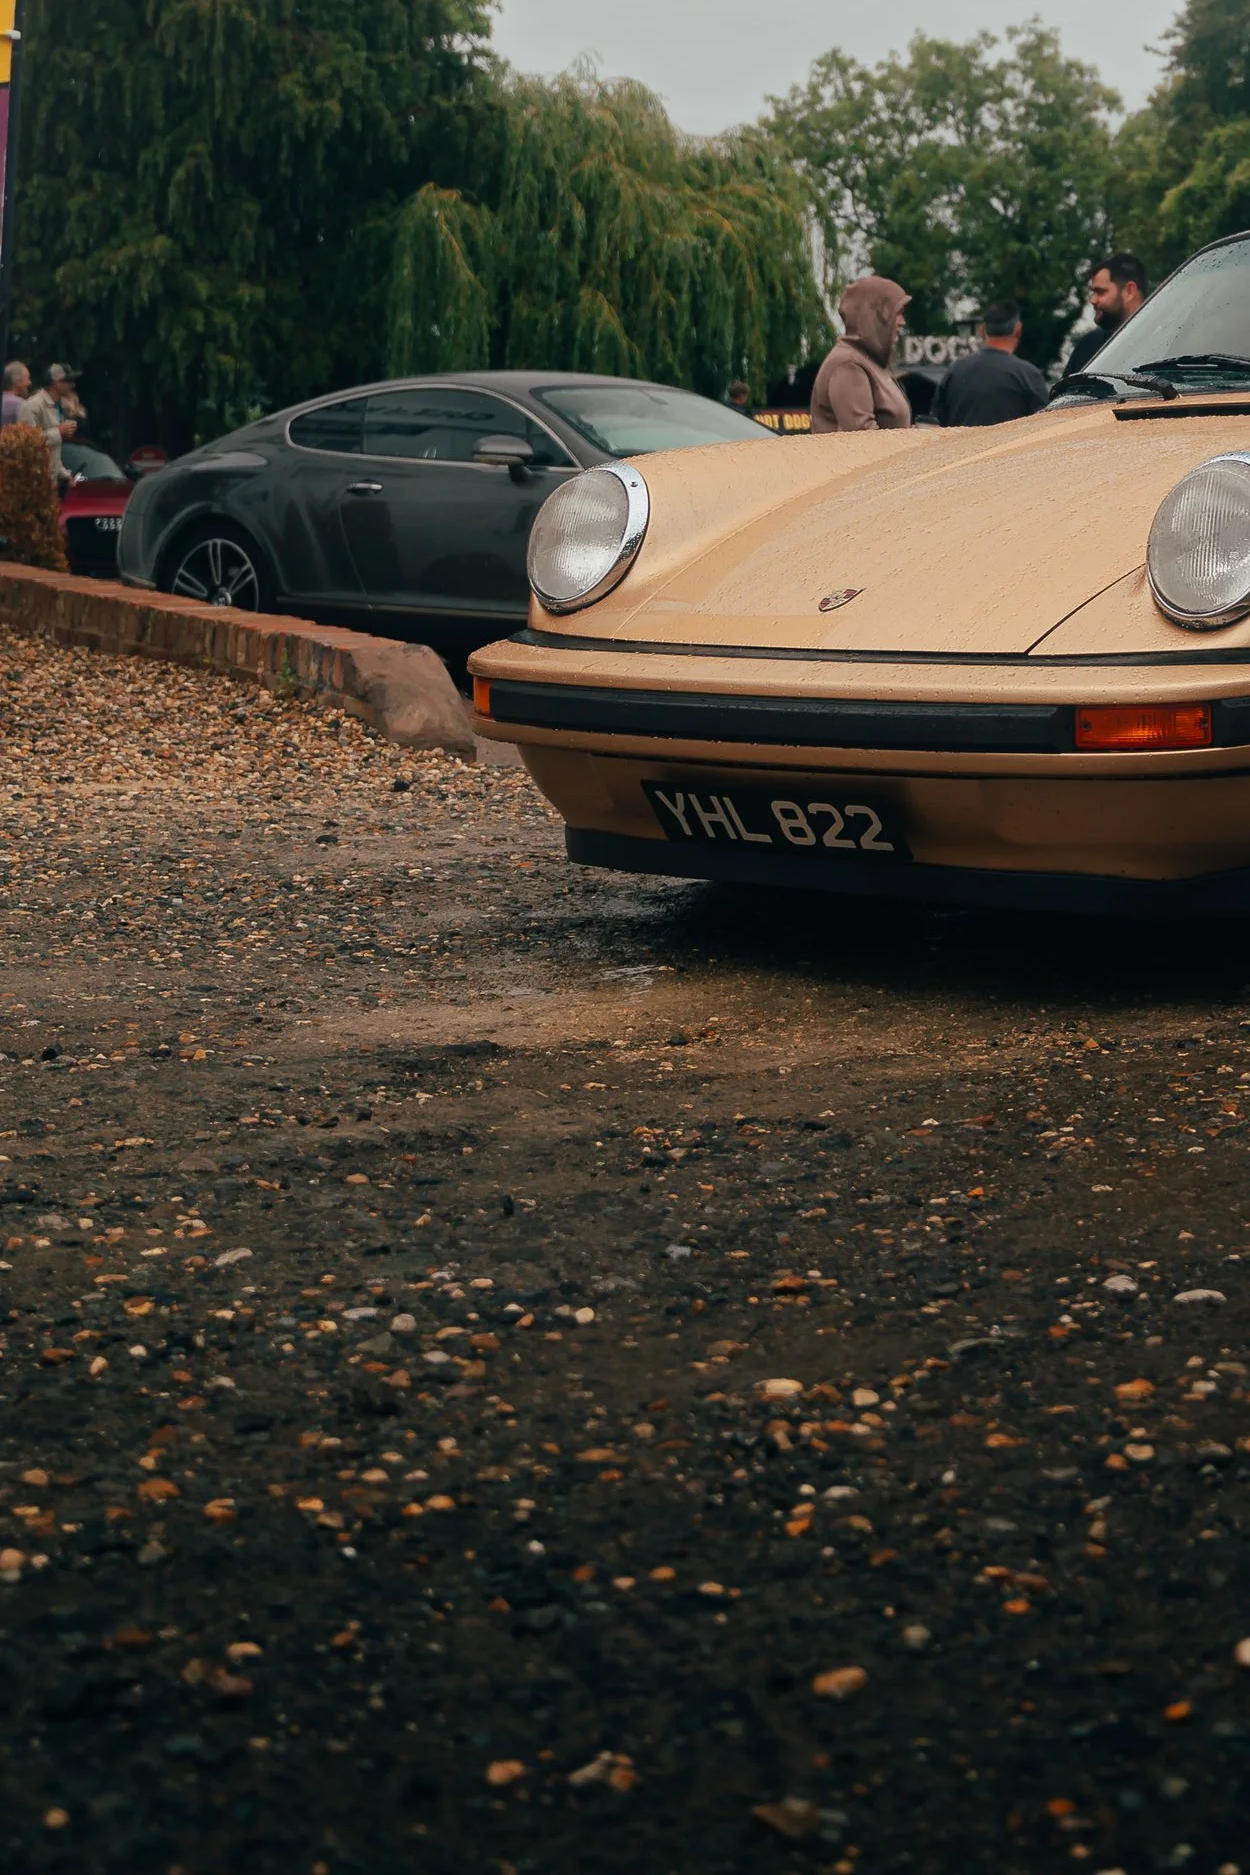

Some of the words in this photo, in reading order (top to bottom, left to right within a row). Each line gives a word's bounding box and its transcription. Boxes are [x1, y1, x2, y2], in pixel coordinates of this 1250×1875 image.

[783, 413, 813, 430] DOG
[655, 790, 773, 843] YHL
[771, 800, 895, 851] 822
